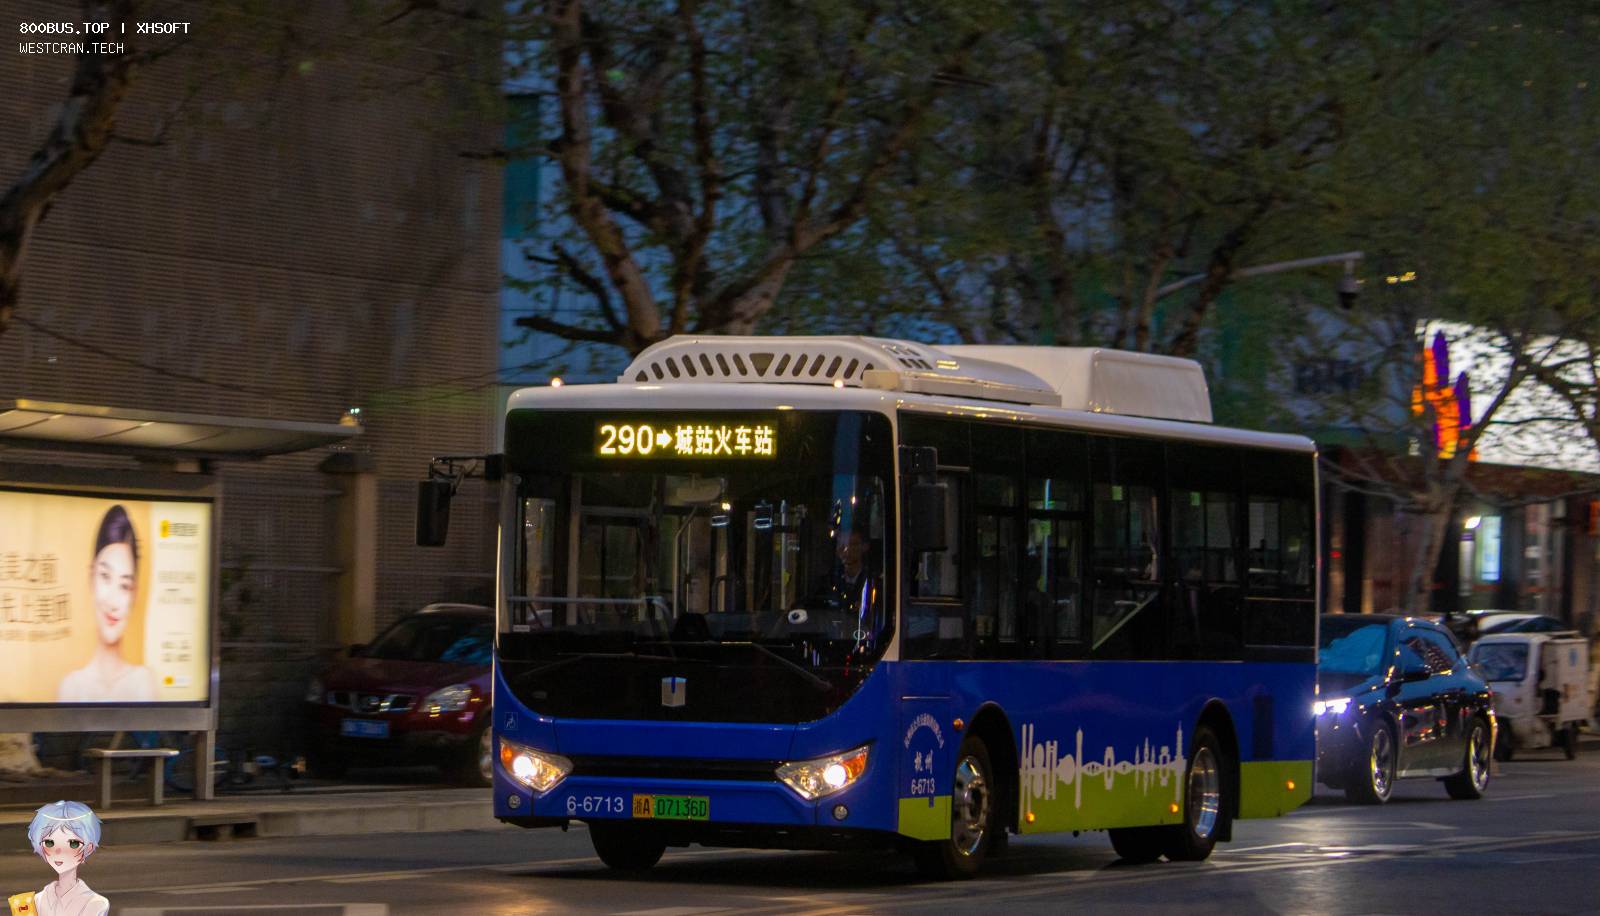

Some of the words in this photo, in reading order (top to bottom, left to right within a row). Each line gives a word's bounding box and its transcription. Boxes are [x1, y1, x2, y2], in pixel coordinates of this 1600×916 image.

[600, 424, 654, 455] 290
[674, 425, 774, 456] 城站火车站
[911, 778, 936, 795] 6-6713
[566, 796, 624, 813] 6-6713
